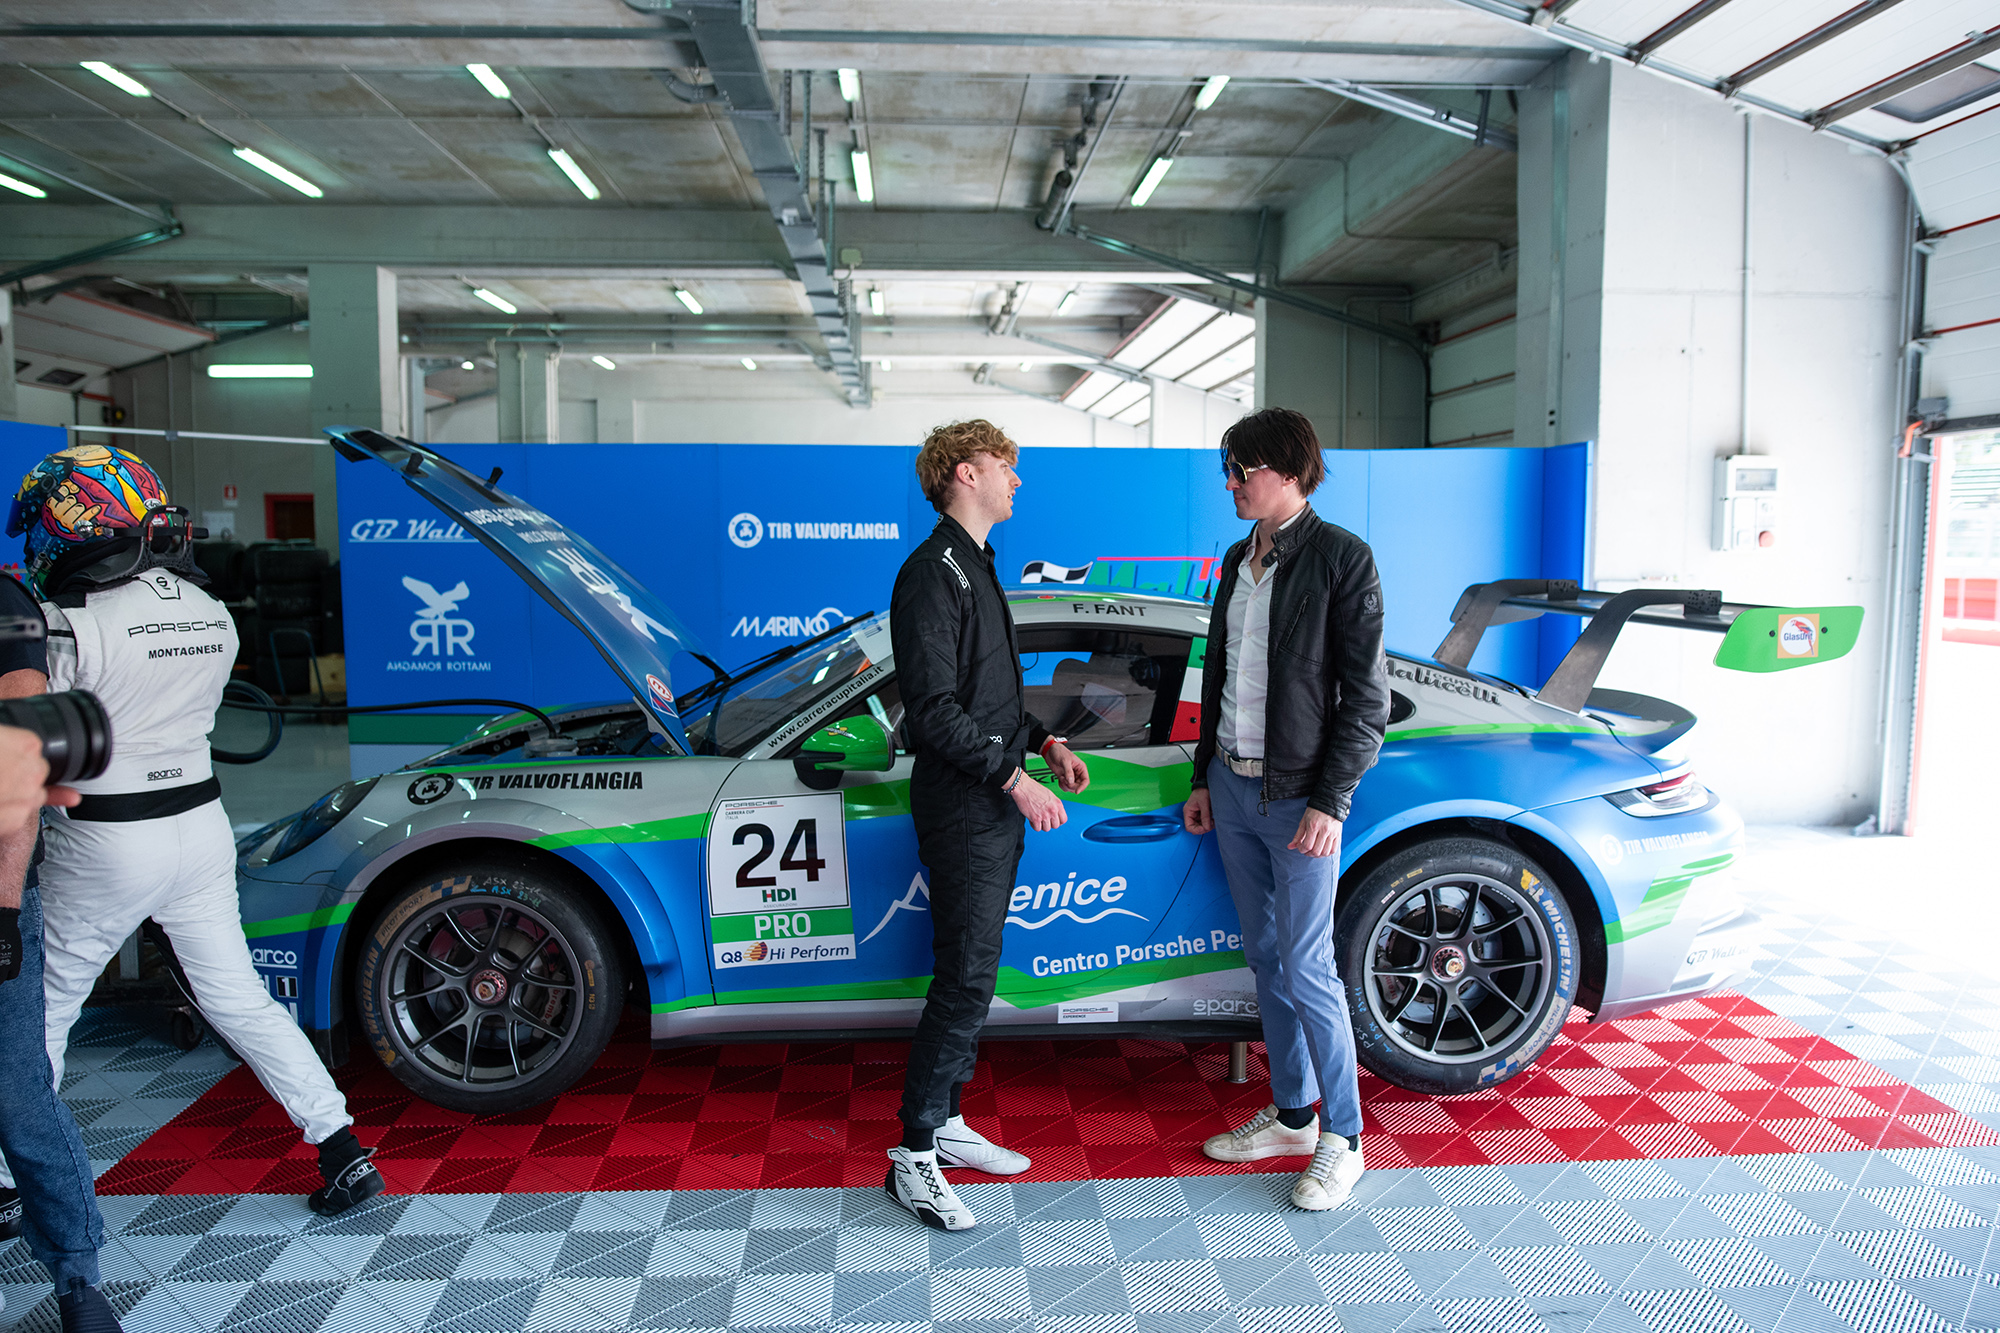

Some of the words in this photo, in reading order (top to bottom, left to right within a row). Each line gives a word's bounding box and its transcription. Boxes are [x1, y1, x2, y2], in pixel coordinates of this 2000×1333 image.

[351, 519, 399, 541] GB
[407, 519, 464, 540] Wall
[767, 522, 792, 539] TIR
[795, 522, 900, 540] VALVOFLANGIA
[1073, 603, 1089, 614] F.
[1094, 603, 1147, 617] FANT
[128, 620, 227, 637] PORSCHE
[149, 644, 224, 659] MONTAGNESE
[447, 661, 491, 672] ROTTAMI
[768, 664, 884, 748] www.carreracupitalia.it
[147, 768, 182, 781] sparco
[498, 772, 643, 790] VALVOFLANGIA
[725, 800, 778, 808] PORSCHE
[732, 818, 826, 888] 24
[1624, 838, 1644, 855] TIR
[762, 888, 797, 902] HDI
[1008, 872, 1127, 912] enice
[381, 916, 399, 937] PILOT
[399, 895, 423, 916] SPORT
[754, 913, 811, 938] PRO
[721, 951, 743, 963] Q8
[770, 948, 785, 960] Hi
[791, 946, 849, 960] Perform
[1033, 952, 1109, 977] Centro
[1115, 934, 1206, 965] Porsche
[1542, 899, 1571, 995] MICHELIN
[252, 948, 298, 969] arco
[1686, 950, 1708, 966] GB
[362, 947, 380, 1035] MICHELIN
[1193, 999, 1260, 1019] sparc
[1546, 1005, 1561, 1031] PILOT
[1523, 1031, 1547, 1057] SPORT
[346, 1161, 377, 1187] spar
